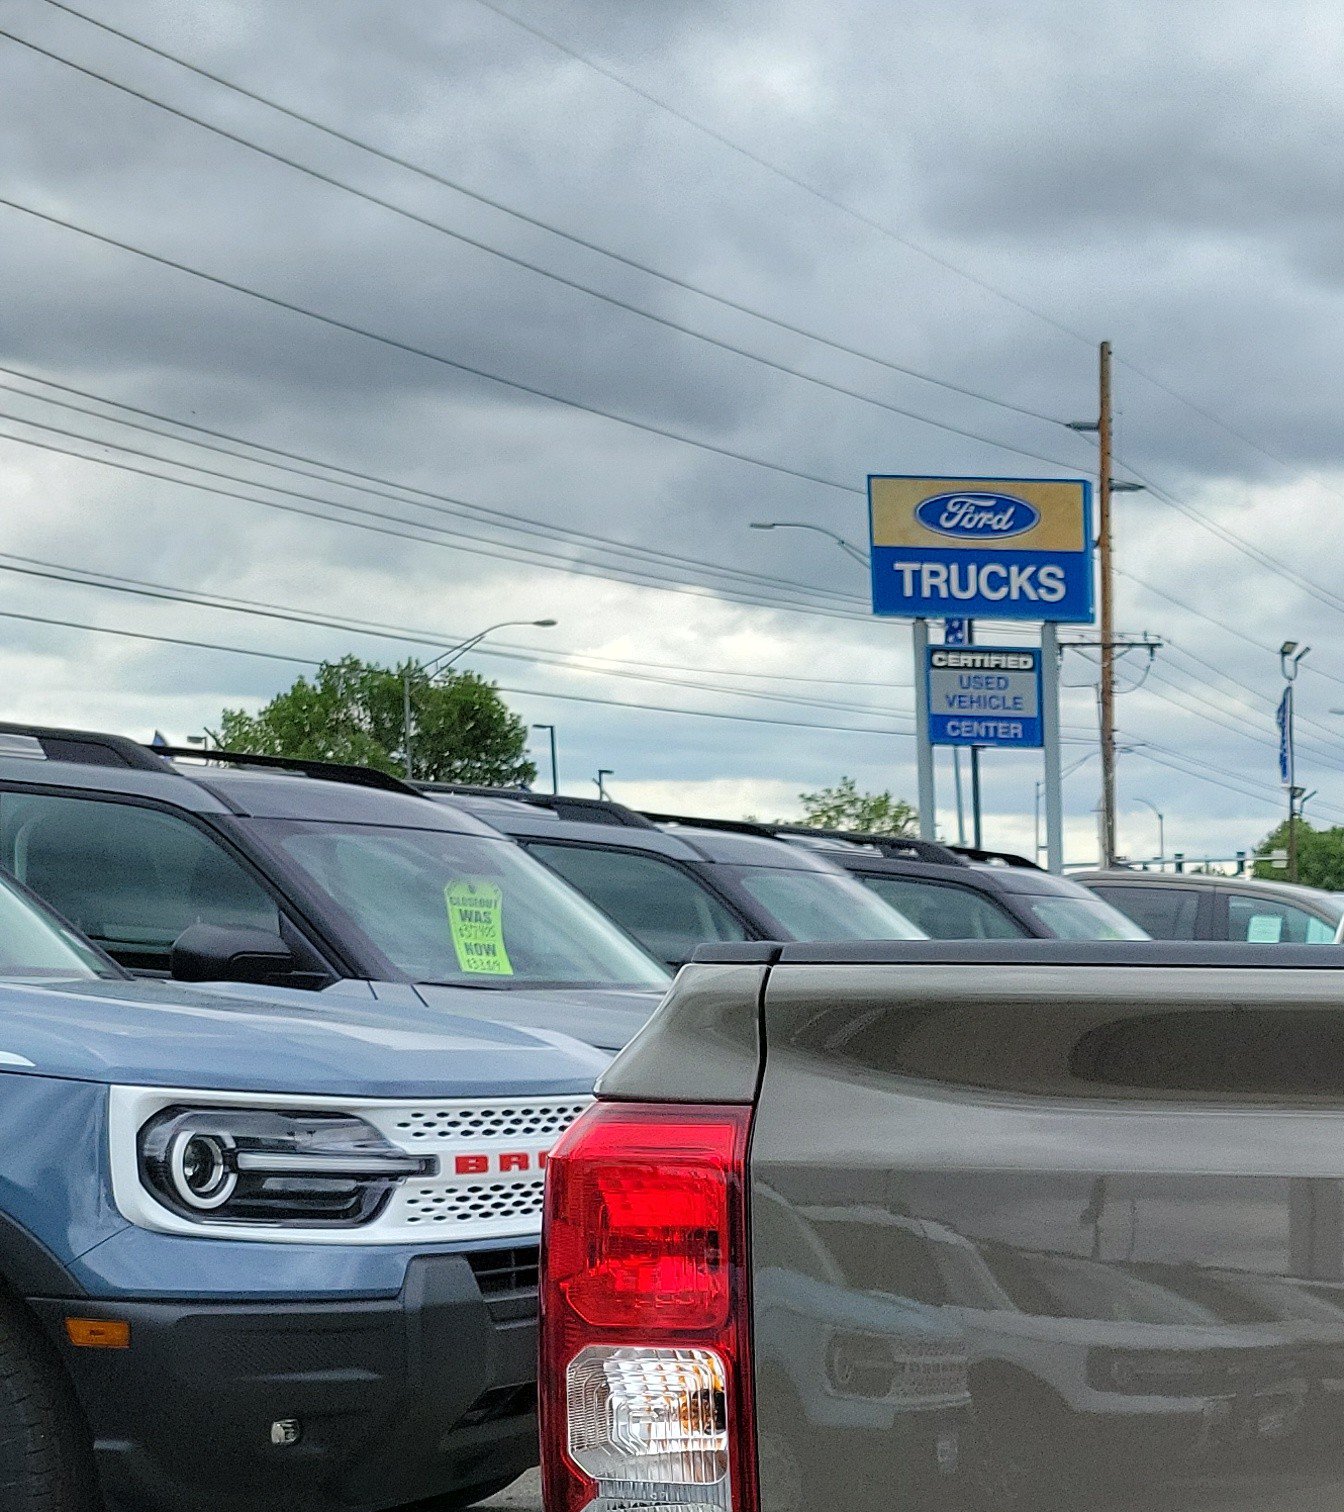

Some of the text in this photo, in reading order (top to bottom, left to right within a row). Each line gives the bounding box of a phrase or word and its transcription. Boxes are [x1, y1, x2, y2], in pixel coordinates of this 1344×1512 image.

[939, 497, 1015, 531] Ford
[893, 561, 1067, 602] TRUCKS
[932, 650, 1034, 669] CERTIFIED
[959, 674, 1009, 690] USED
[945, 694, 1024, 710] VEHICLE
[946, 720, 1023, 738] CENTER
[459, 908, 493, 924] WAS
[464, 942, 497, 957] NOW
